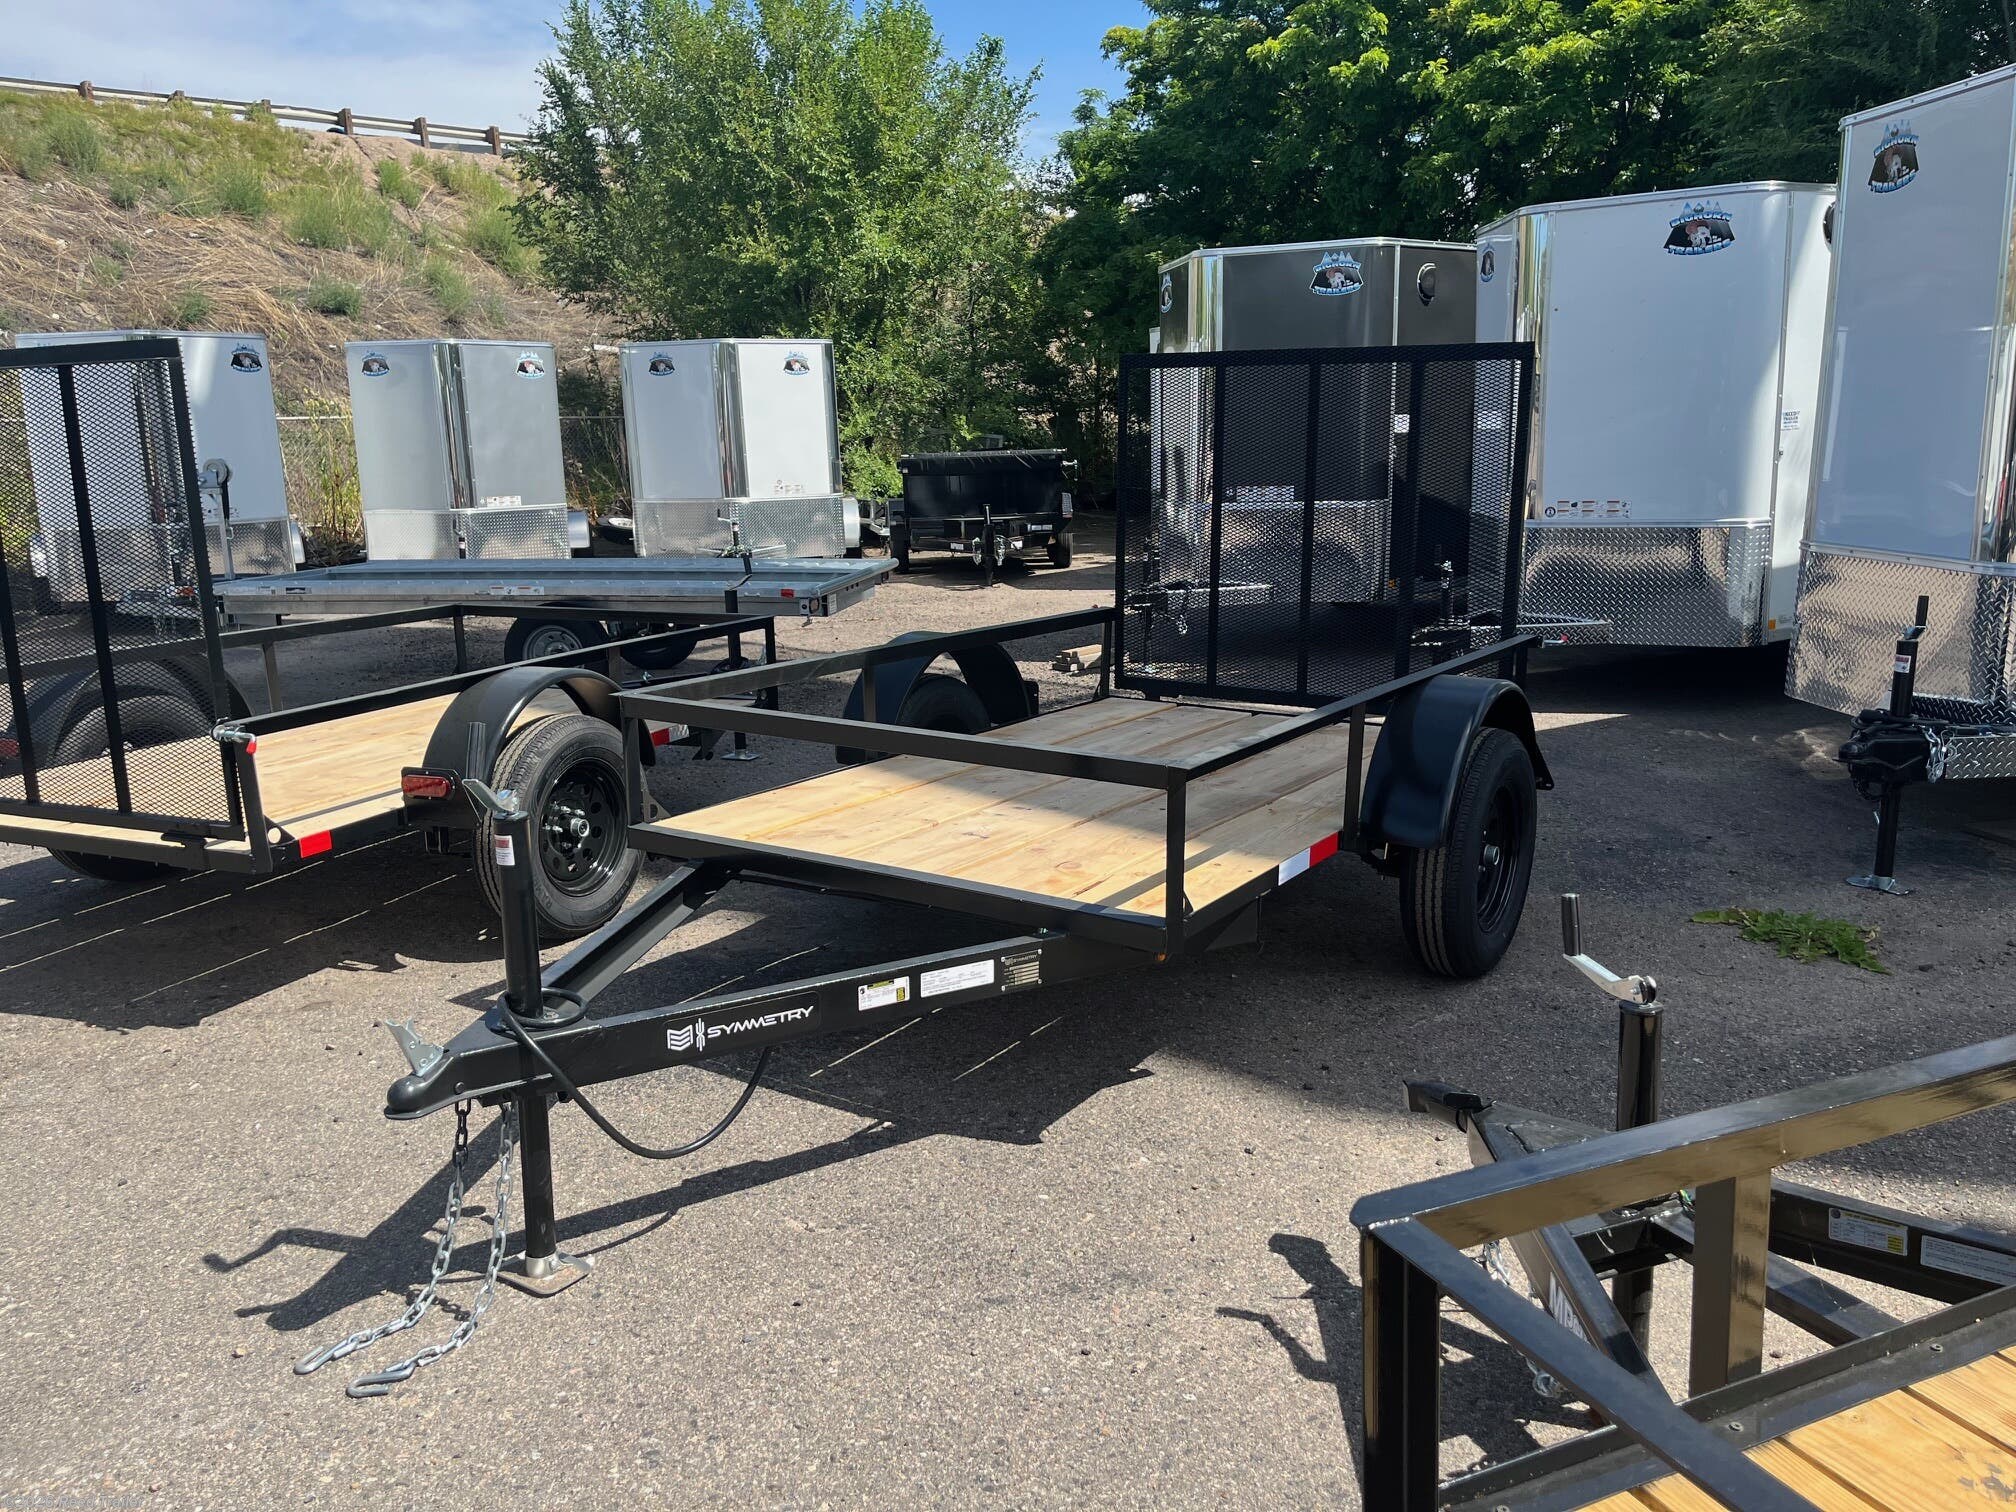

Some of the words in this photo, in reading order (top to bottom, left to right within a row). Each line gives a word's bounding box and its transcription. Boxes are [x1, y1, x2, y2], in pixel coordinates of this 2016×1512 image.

[1874, 134, 1919, 158] BIGHORN
[1870, 169, 1917, 193] TRAILERS
[1669, 211, 1733, 228] BIGHORN
[1668, 238, 1732, 255] TRAILERS
[707, 1005, 814, 1039] SYMMETRY
